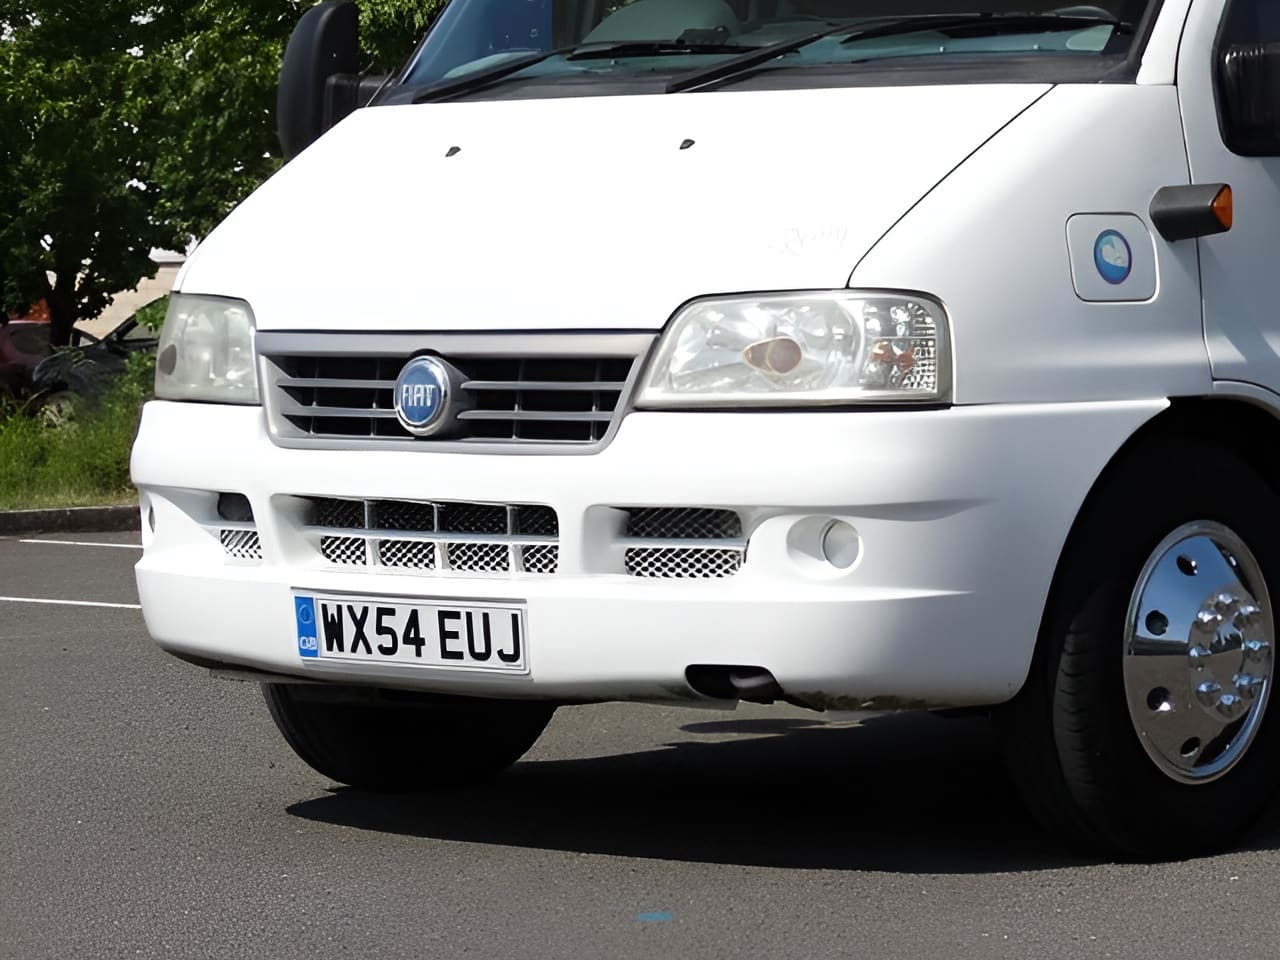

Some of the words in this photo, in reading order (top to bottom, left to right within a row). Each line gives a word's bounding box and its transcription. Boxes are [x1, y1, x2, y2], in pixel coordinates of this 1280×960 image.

[402, 384, 437, 407] FIAT
[321, 603, 426, 658] WX54
[437, 610, 521, 663] EUJ
